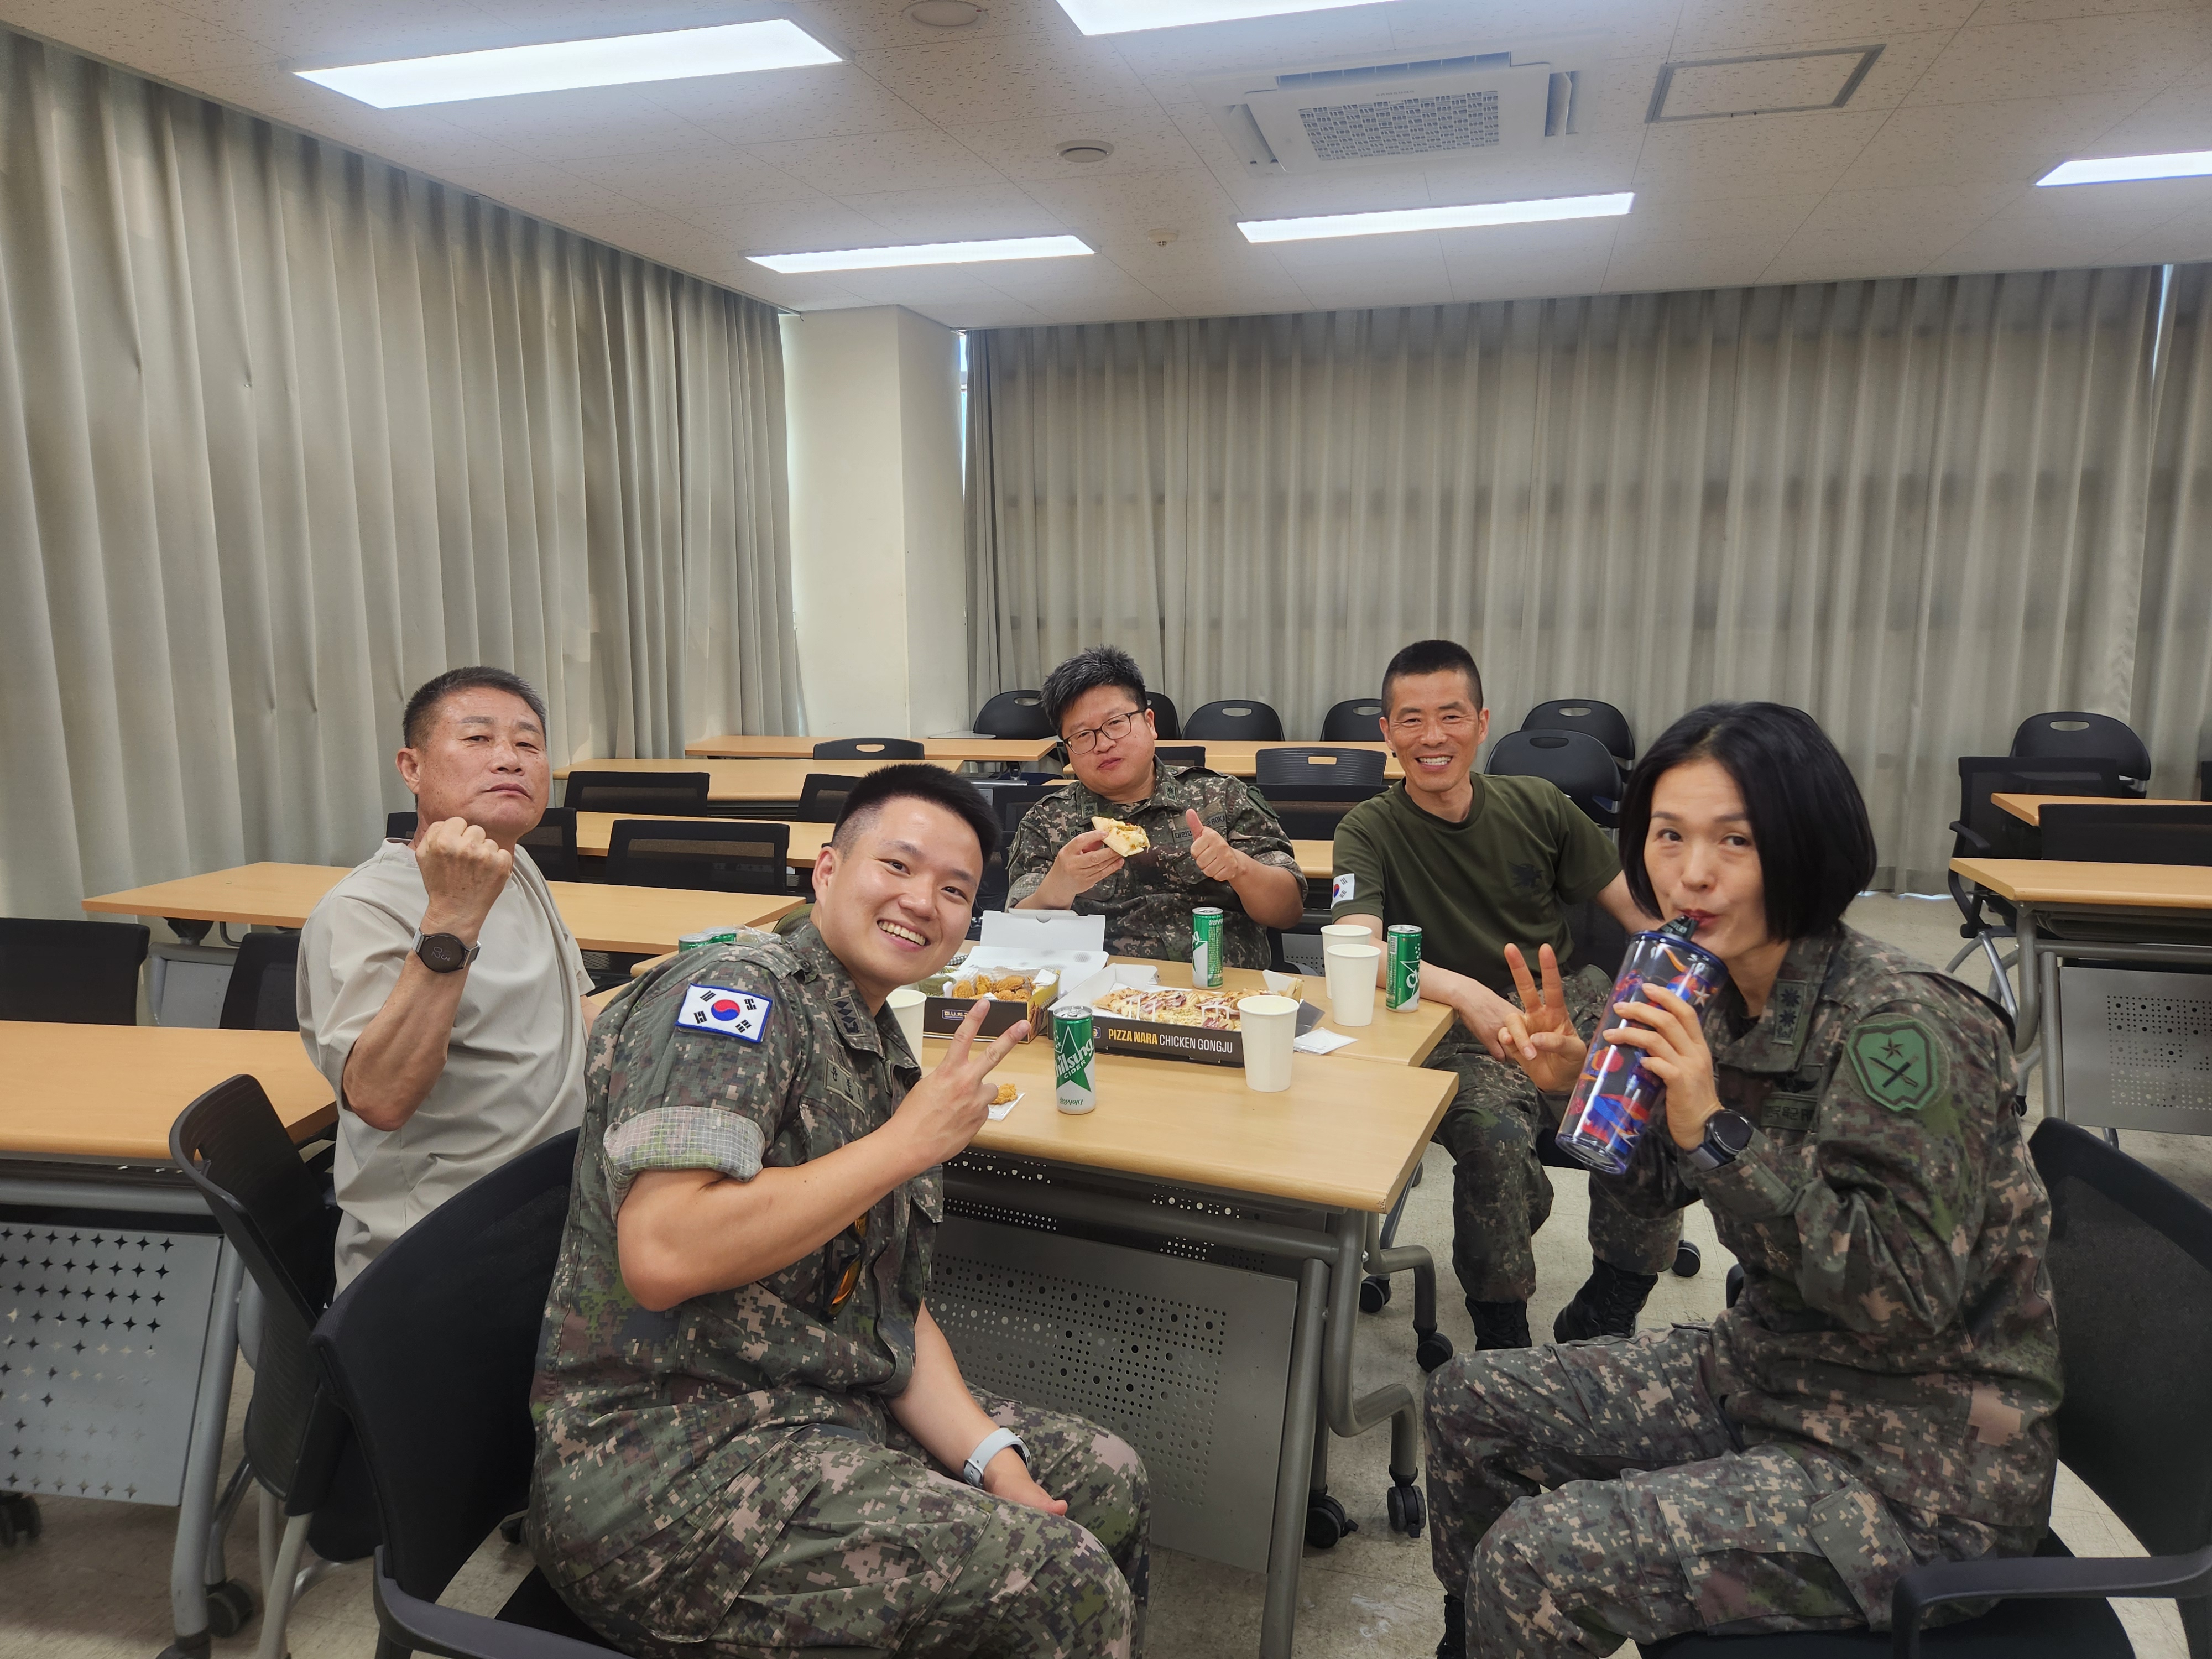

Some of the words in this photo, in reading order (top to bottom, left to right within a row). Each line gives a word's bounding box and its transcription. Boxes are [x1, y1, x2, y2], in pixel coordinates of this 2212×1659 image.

[1211, 815, 1225, 825] ROKA
[1108, 1028, 1132, 1042] PIZZA
[1134, 1031, 1157, 1045] NARA
[1159, 1034, 1196, 1049] CHICKEN
[1198, 1039, 1233, 1053] GONGJU
[1055, 1038, 1093, 1077] hilsung
[1063, 1060, 1086, 1079] CIDER
[1060, 1097, 1083, 1106] 칠성사이다
